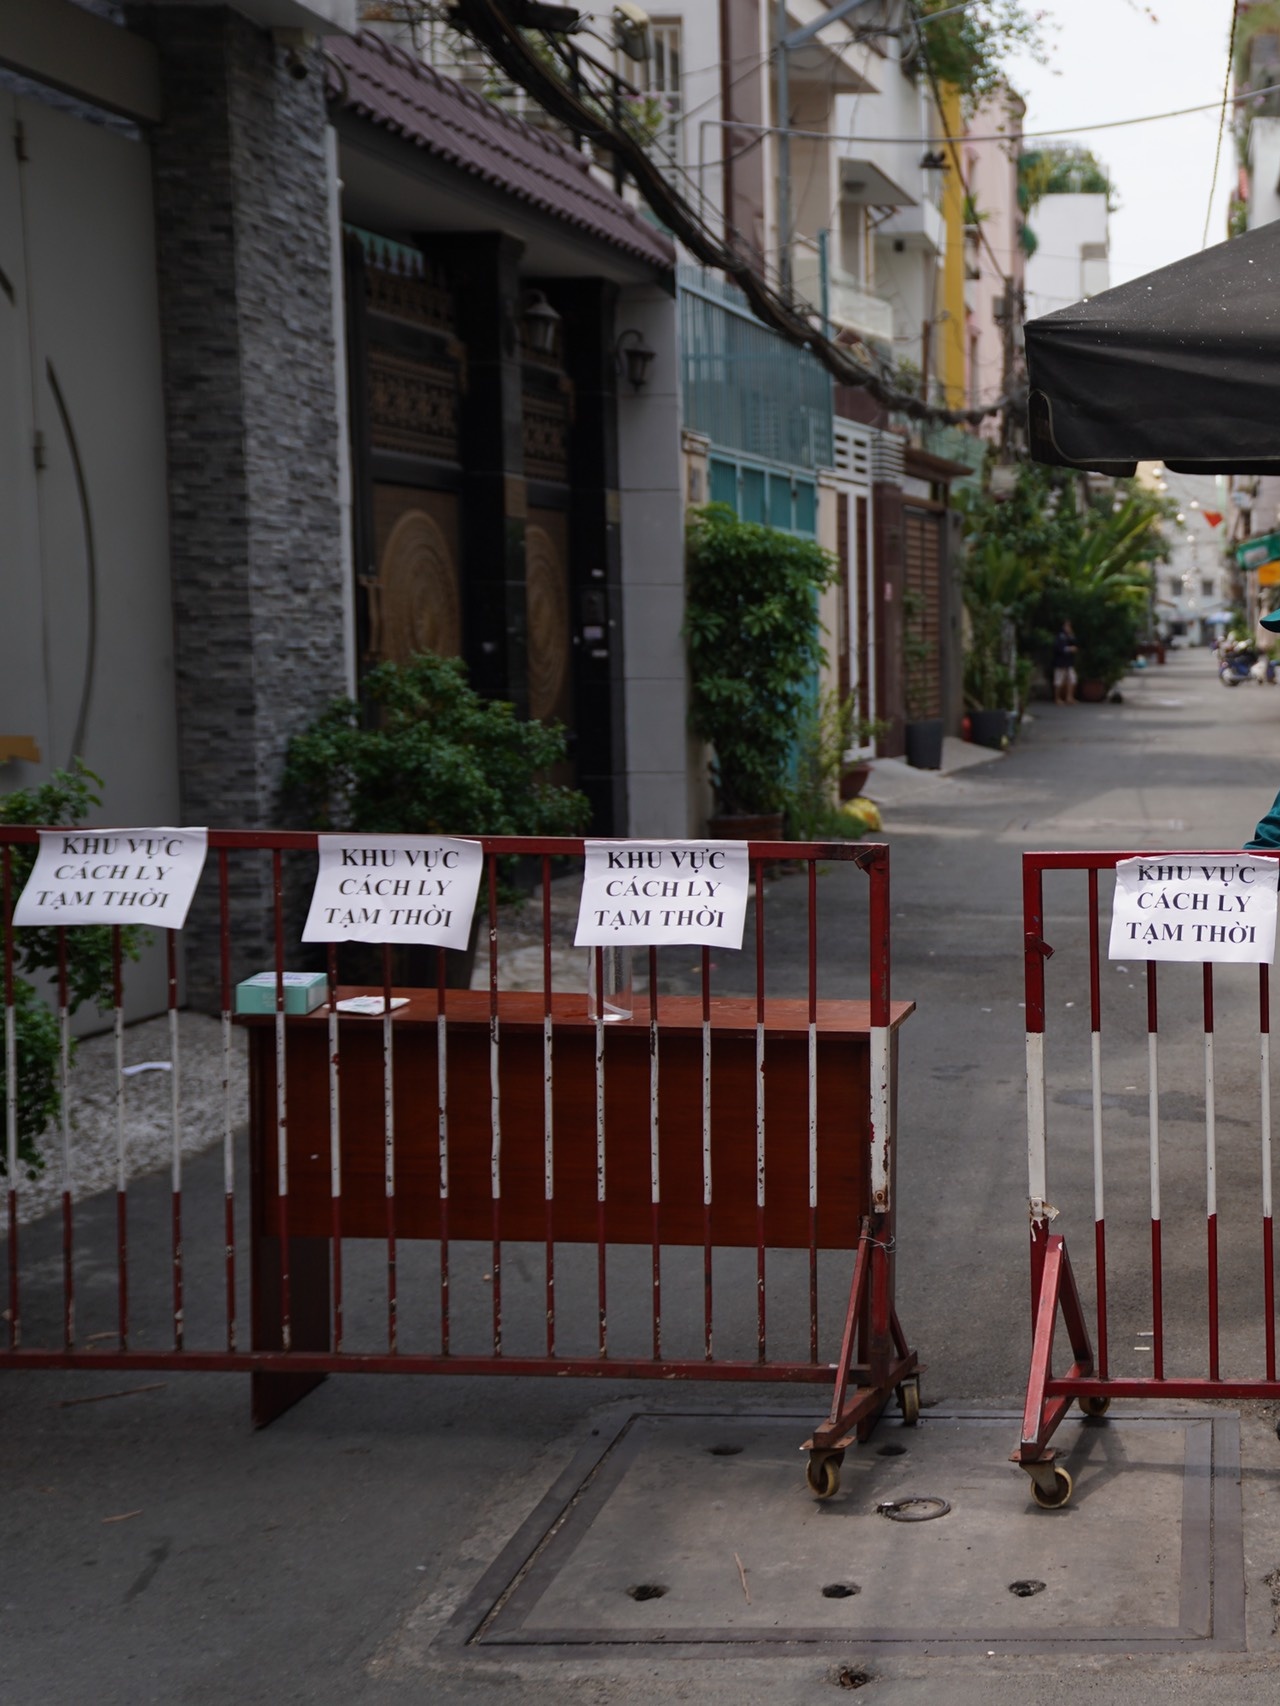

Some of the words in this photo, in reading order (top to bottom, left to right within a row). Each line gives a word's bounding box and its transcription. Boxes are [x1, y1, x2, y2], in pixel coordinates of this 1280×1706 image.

[61, 837, 119, 854] KHU
[127, 836, 183, 859] VỰC
[341, 848, 396, 867] KHU
[404, 847, 460, 872] VỰC
[54, 860, 129, 880] CÁCH
[135, 865, 173, 880] LY
[607, 851, 662, 869] KHU
[670, 848, 726, 874] VỰC
[339, 874, 411, 896] CÁCH
[417, 879, 452, 896] LY
[605, 875, 679, 897] CÁCH
[687, 881, 722, 897] LY
[1136, 864, 1192, 881] KHU
[1199, 863, 1256, 887] VỰC
[36, 890, 95, 910] TẠM
[102, 887, 170, 908] THỜI
[1136, 887, 1209, 911] CÁCH
[1218, 894, 1252, 913] LY
[324, 907, 381, 928] TẠM
[389, 904, 453, 928] THỜI
[594, 909, 652, 931] TẠM
[659, 905, 726, 928] THỜI
[1125, 922, 1184, 945] TẠM
[1191, 921, 1257, 944] THỜI
